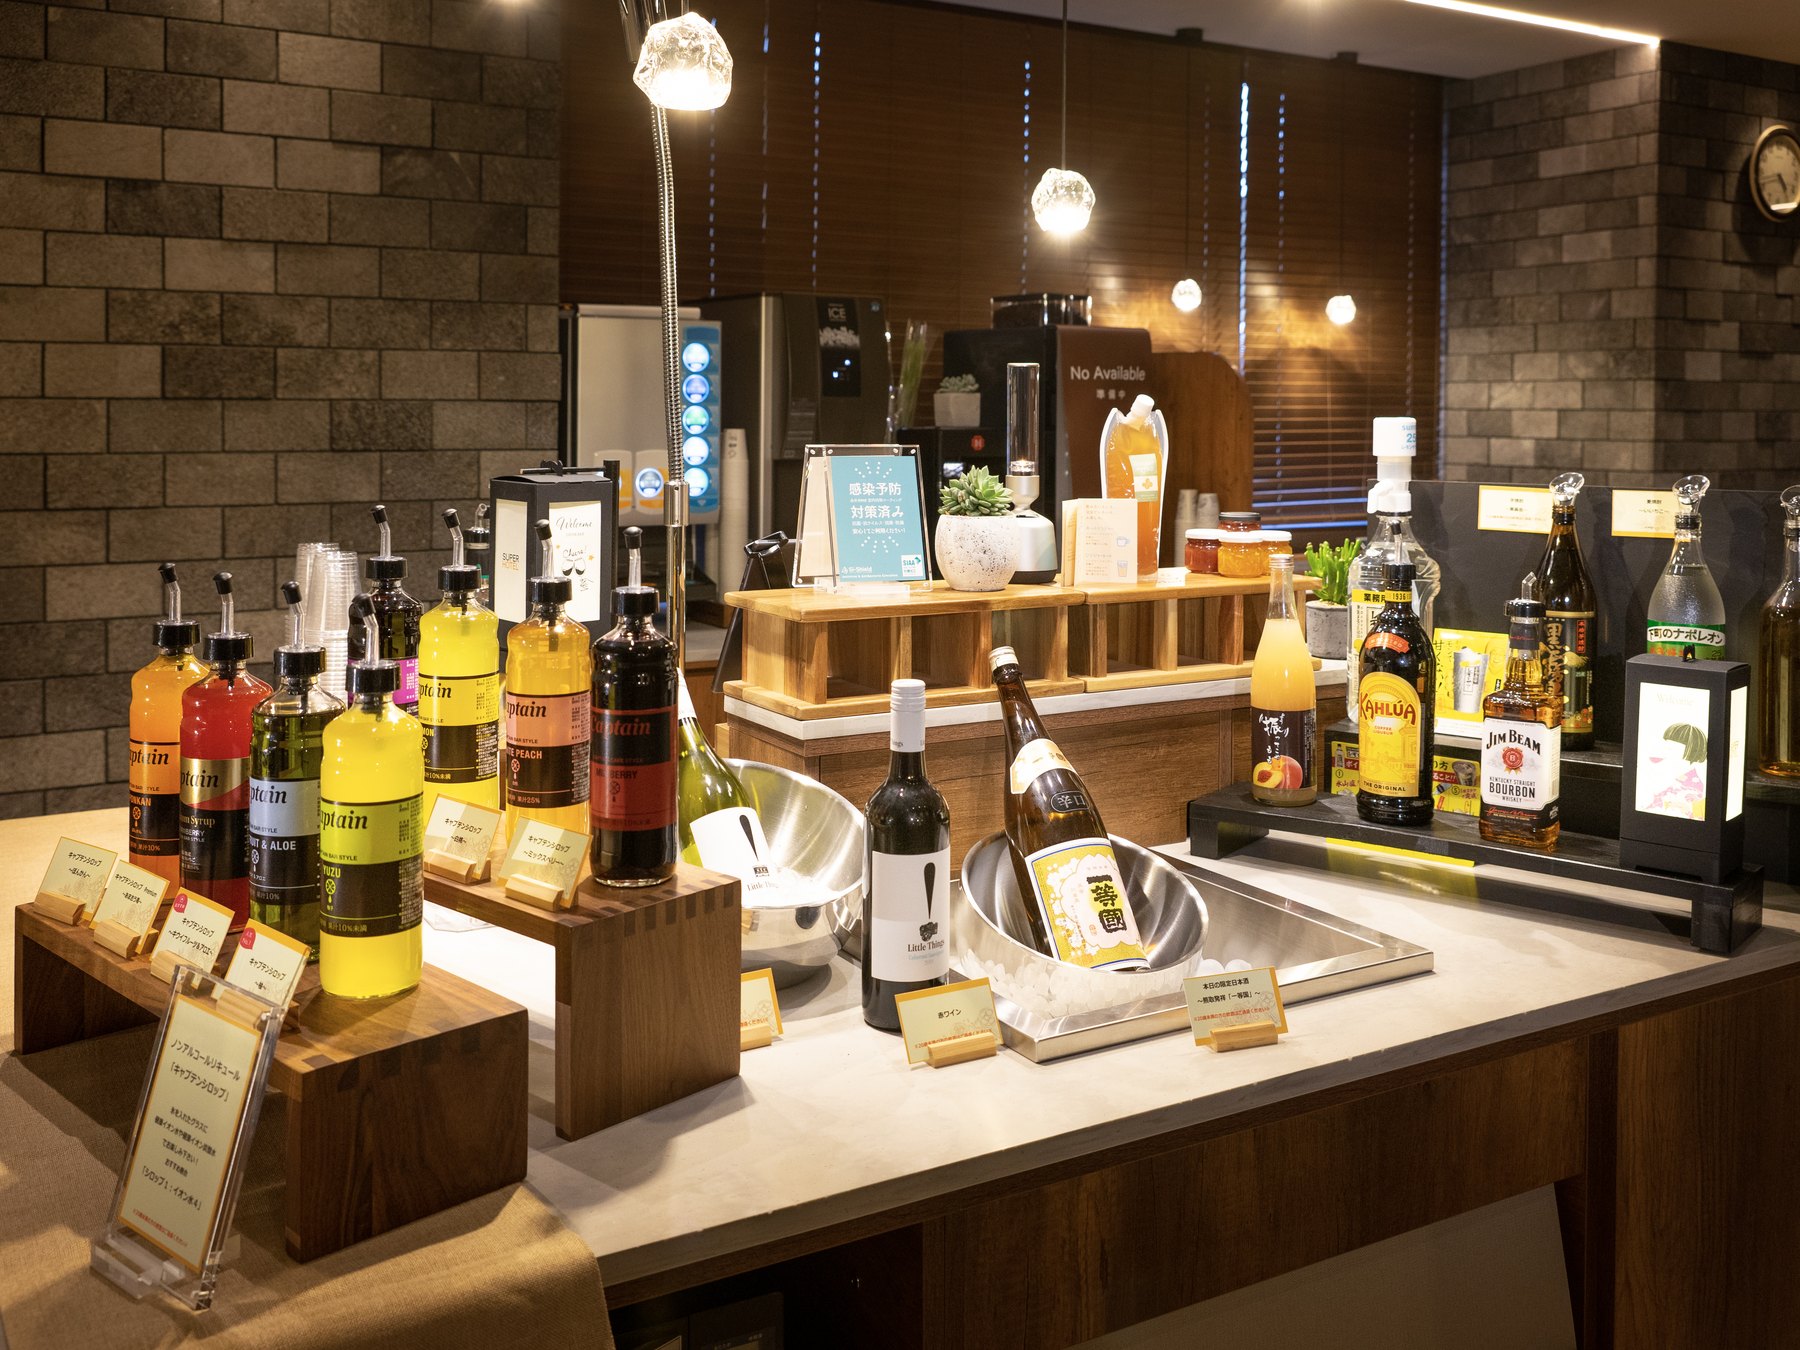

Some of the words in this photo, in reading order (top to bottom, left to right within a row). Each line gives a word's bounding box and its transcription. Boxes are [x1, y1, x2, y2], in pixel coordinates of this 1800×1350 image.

[828, 307, 846, 321] ICE
[1070, 366, 1090, 380] No
[1093, 365, 1146, 381] Available
[849, 482, 902, 496] 感染予防
[850, 505, 904, 519] 対策済み
[555, 516, 593, 531] Welcome
[502, 552, 520, 562] SUPER
[1648, 628, 1723, 645] 下町のナポレオン
[419, 682, 452, 699] ptain
[1360, 692, 1416, 726] KAHLÚA
[1486, 732, 1506, 749] JIM
[1509, 729, 1541, 755] BEAM
[515, 749, 543, 759] PEACH
[180, 770, 219, 788] ptain
[1489, 776, 1512, 784] KENTUCKY
[1513, 779, 1536, 787] STRAIGHT
[250, 785, 287, 804] ptain
[1373, 783, 1406, 792] ORIGINAL
[1489, 782, 1536, 798] BOURBON
[1502, 795, 1522, 803] WHISKEY
[190, 815, 216, 828] Syrup
[445, 818, 482, 834] キャプテンシロップ
[261, 840, 268, 849] &
[270, 841, 297, 850] ALOE
[528, 835, 571, 853] キャプテンシロップ
[68, 851, 102, 867] キャプテンシロップ
[322, 865, 342, 879] YUZU
[182, 917, 215, 938] キャプテンシロップ
[907, 943, 927, 952] Little
[249, 957, 286, 981] キャプテンシロップ
[1203, 978, 1249, 990] 本日の限定日本酒
[938, 1009, 961, 1019] 赤ワイン
[171, 1039, 240, 1081] ノンアルコールリキュール
[170, 1062, 230, 1102] 「キャプテンシロップ」
